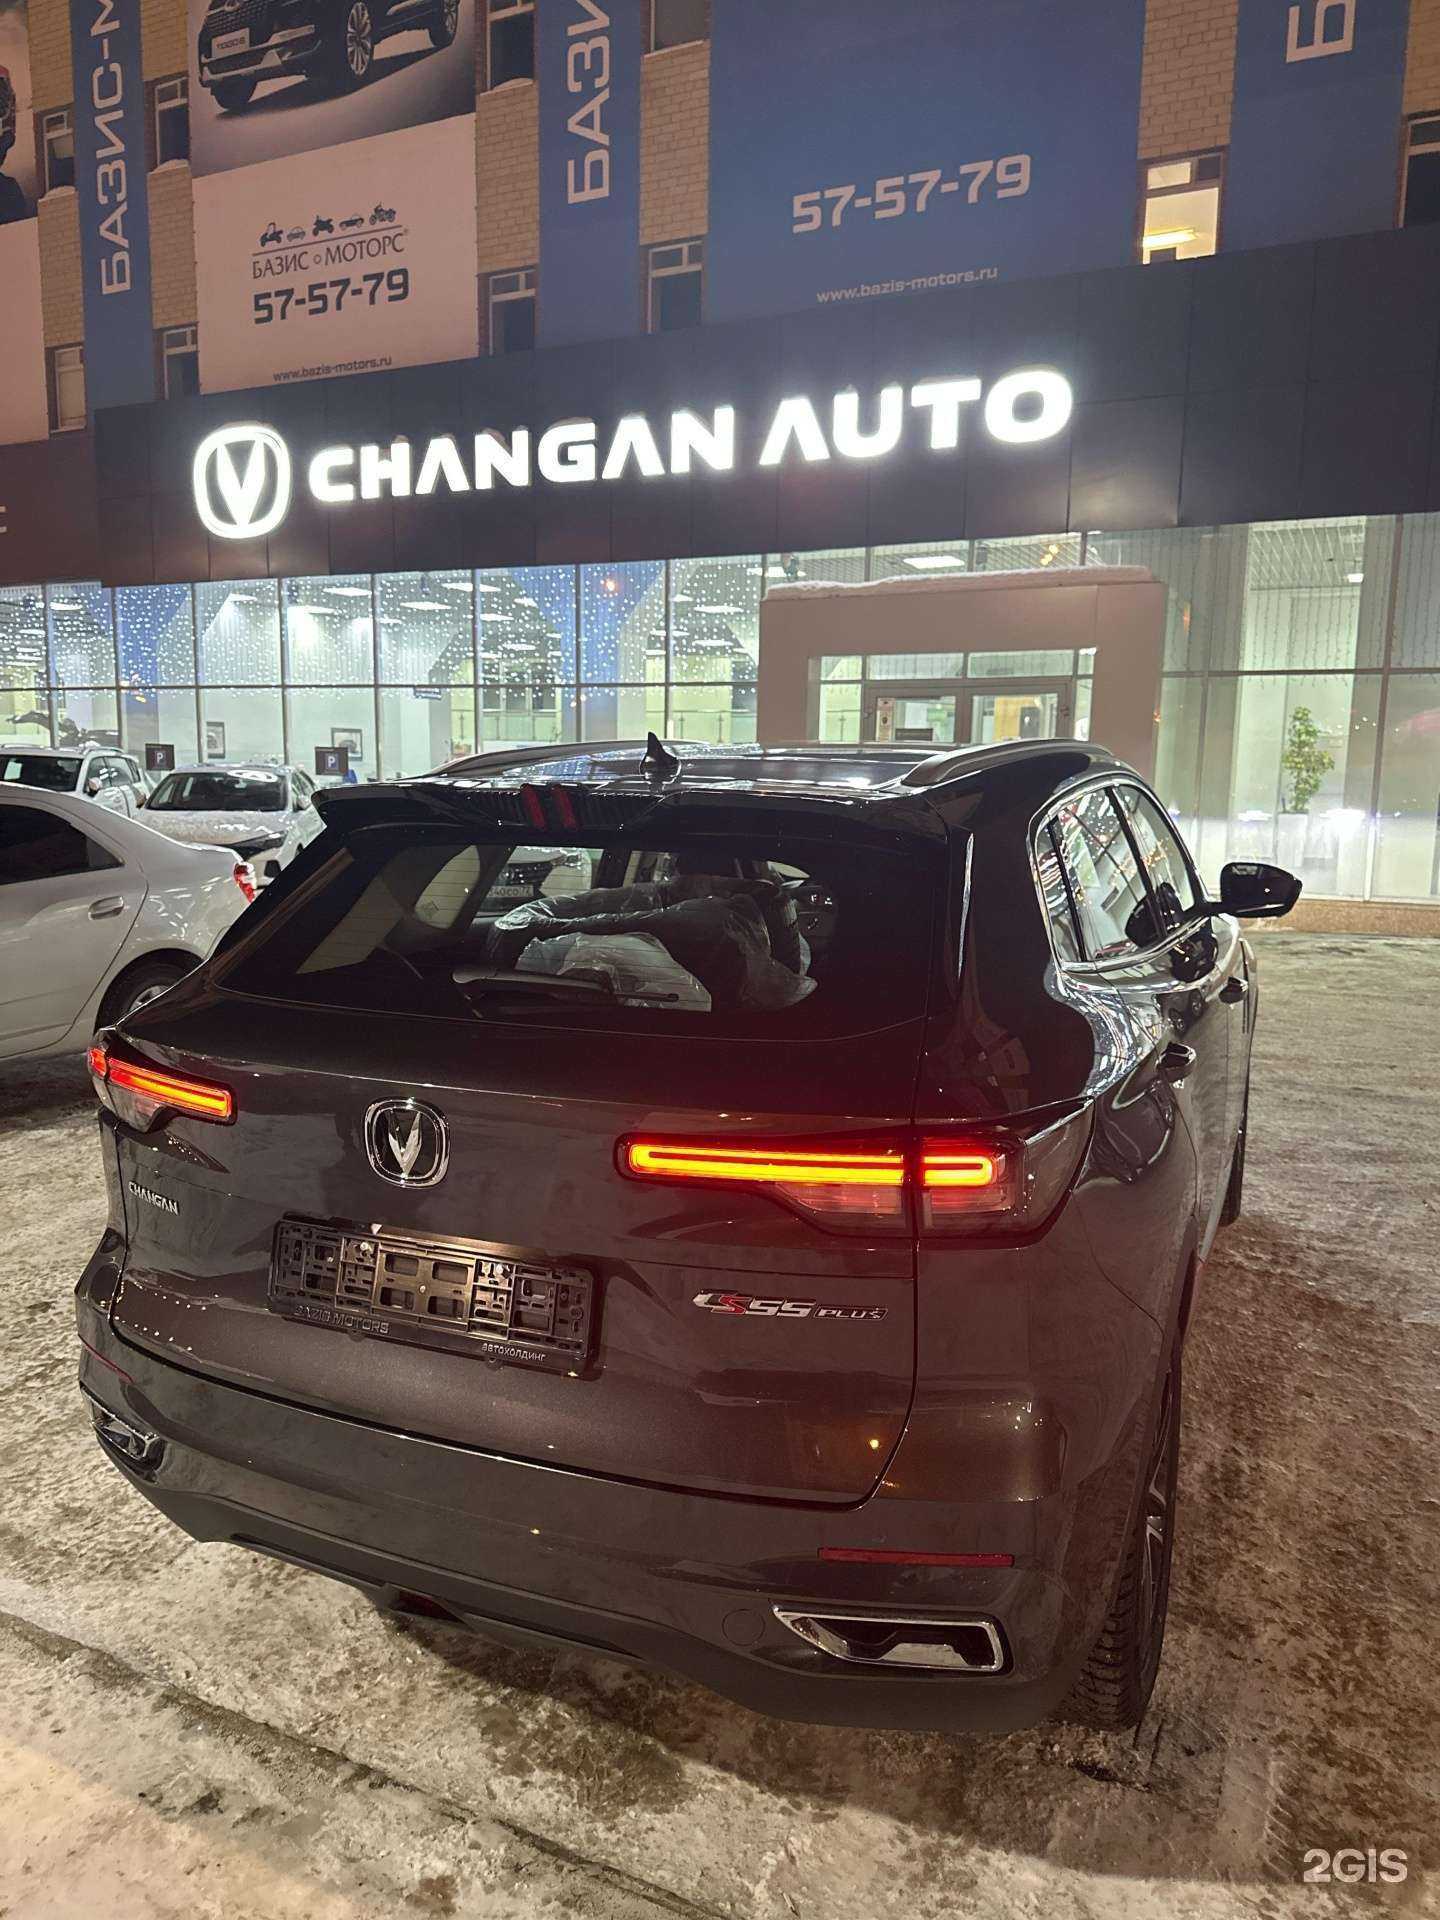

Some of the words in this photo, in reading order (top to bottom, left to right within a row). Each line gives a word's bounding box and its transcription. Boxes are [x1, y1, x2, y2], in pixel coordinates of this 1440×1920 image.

[792, 154, 1031, 234] 57-57-79
[252, 251, 309, 280] БАЗИС
[324, 233, 405, 266] МОТОРС
[253, 268, 410, 325] 57-57-79
[816, 266, 998, 303] www.bazis-motors.ru
[272, 356, 393, 382] www.bazis-motors.ru
[309, 406, 735, 503] CHANGAN
[758, 370, 1074, 467] AUTO
[128, 1181, 179, 1215] CHANGAN
[332, 1313, 389, 1334] MOTORS
[820, 1307, 883, 1320] PLUS
[481, 1342, 547, 1361] автохолдинг
